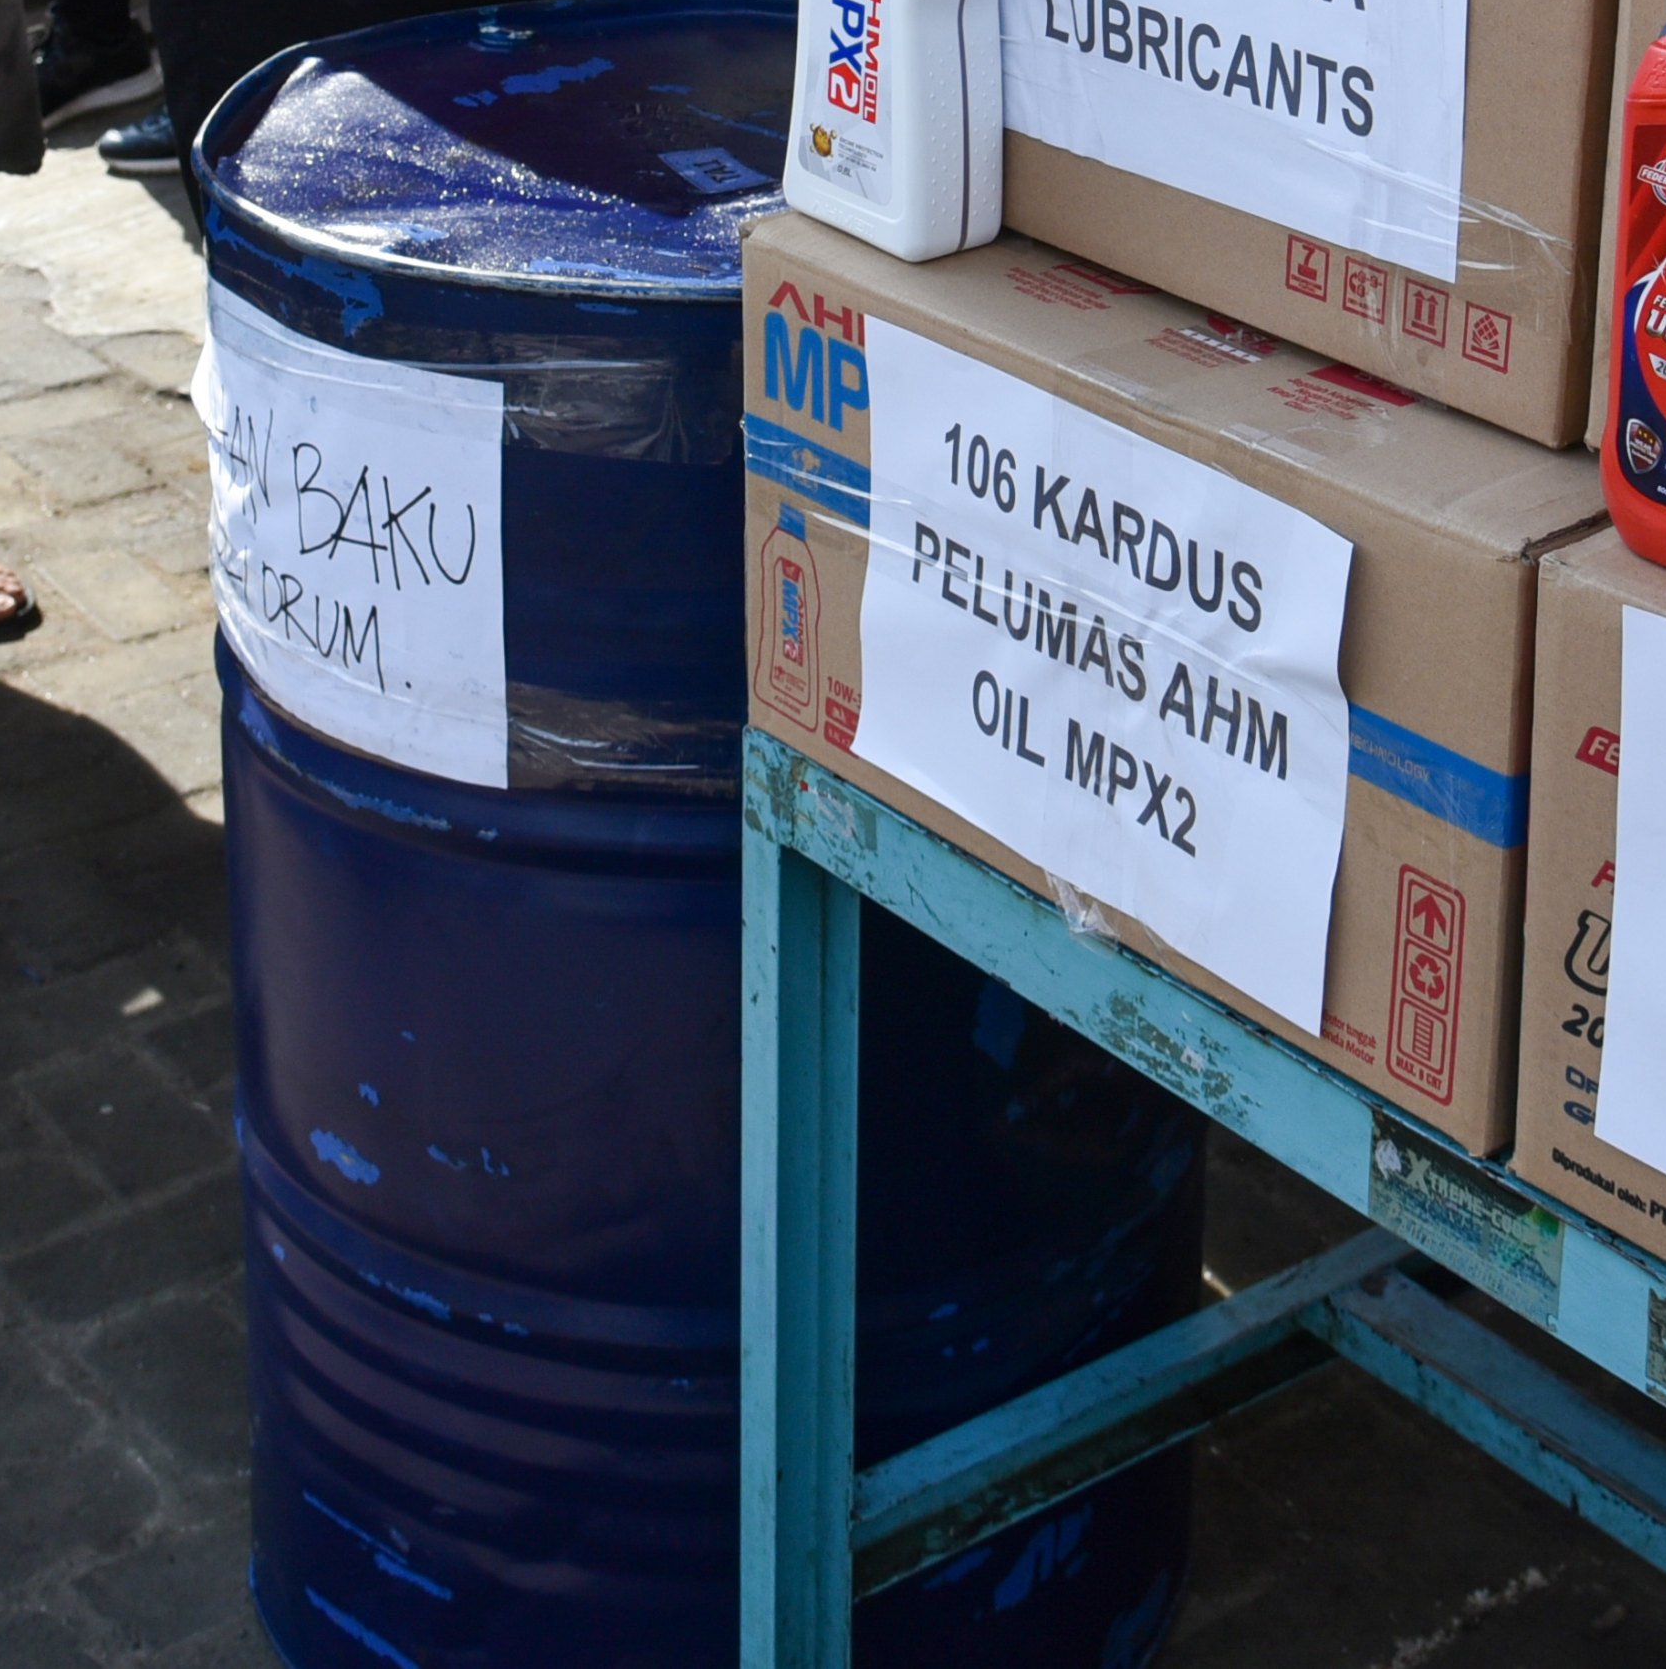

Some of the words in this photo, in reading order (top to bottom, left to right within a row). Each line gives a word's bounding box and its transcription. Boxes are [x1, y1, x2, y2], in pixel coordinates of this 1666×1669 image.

[863, 75, 877, 123] OIL
[764, 312, 870, 432] MP
[292, 442, 476, 592] BAKU
[943, 422, 1018, 513] 106
[1031, 474, 1263, 633] KARDUS
[912, 522, 1147, 701] PELUMAS
[1159, 661, 1290, 780] AHM
[971, 669, 1045, 768] OIL
[1065, 718, 1198, 859] MPX2
[1345, 1039, 1375, 1065] Motor
